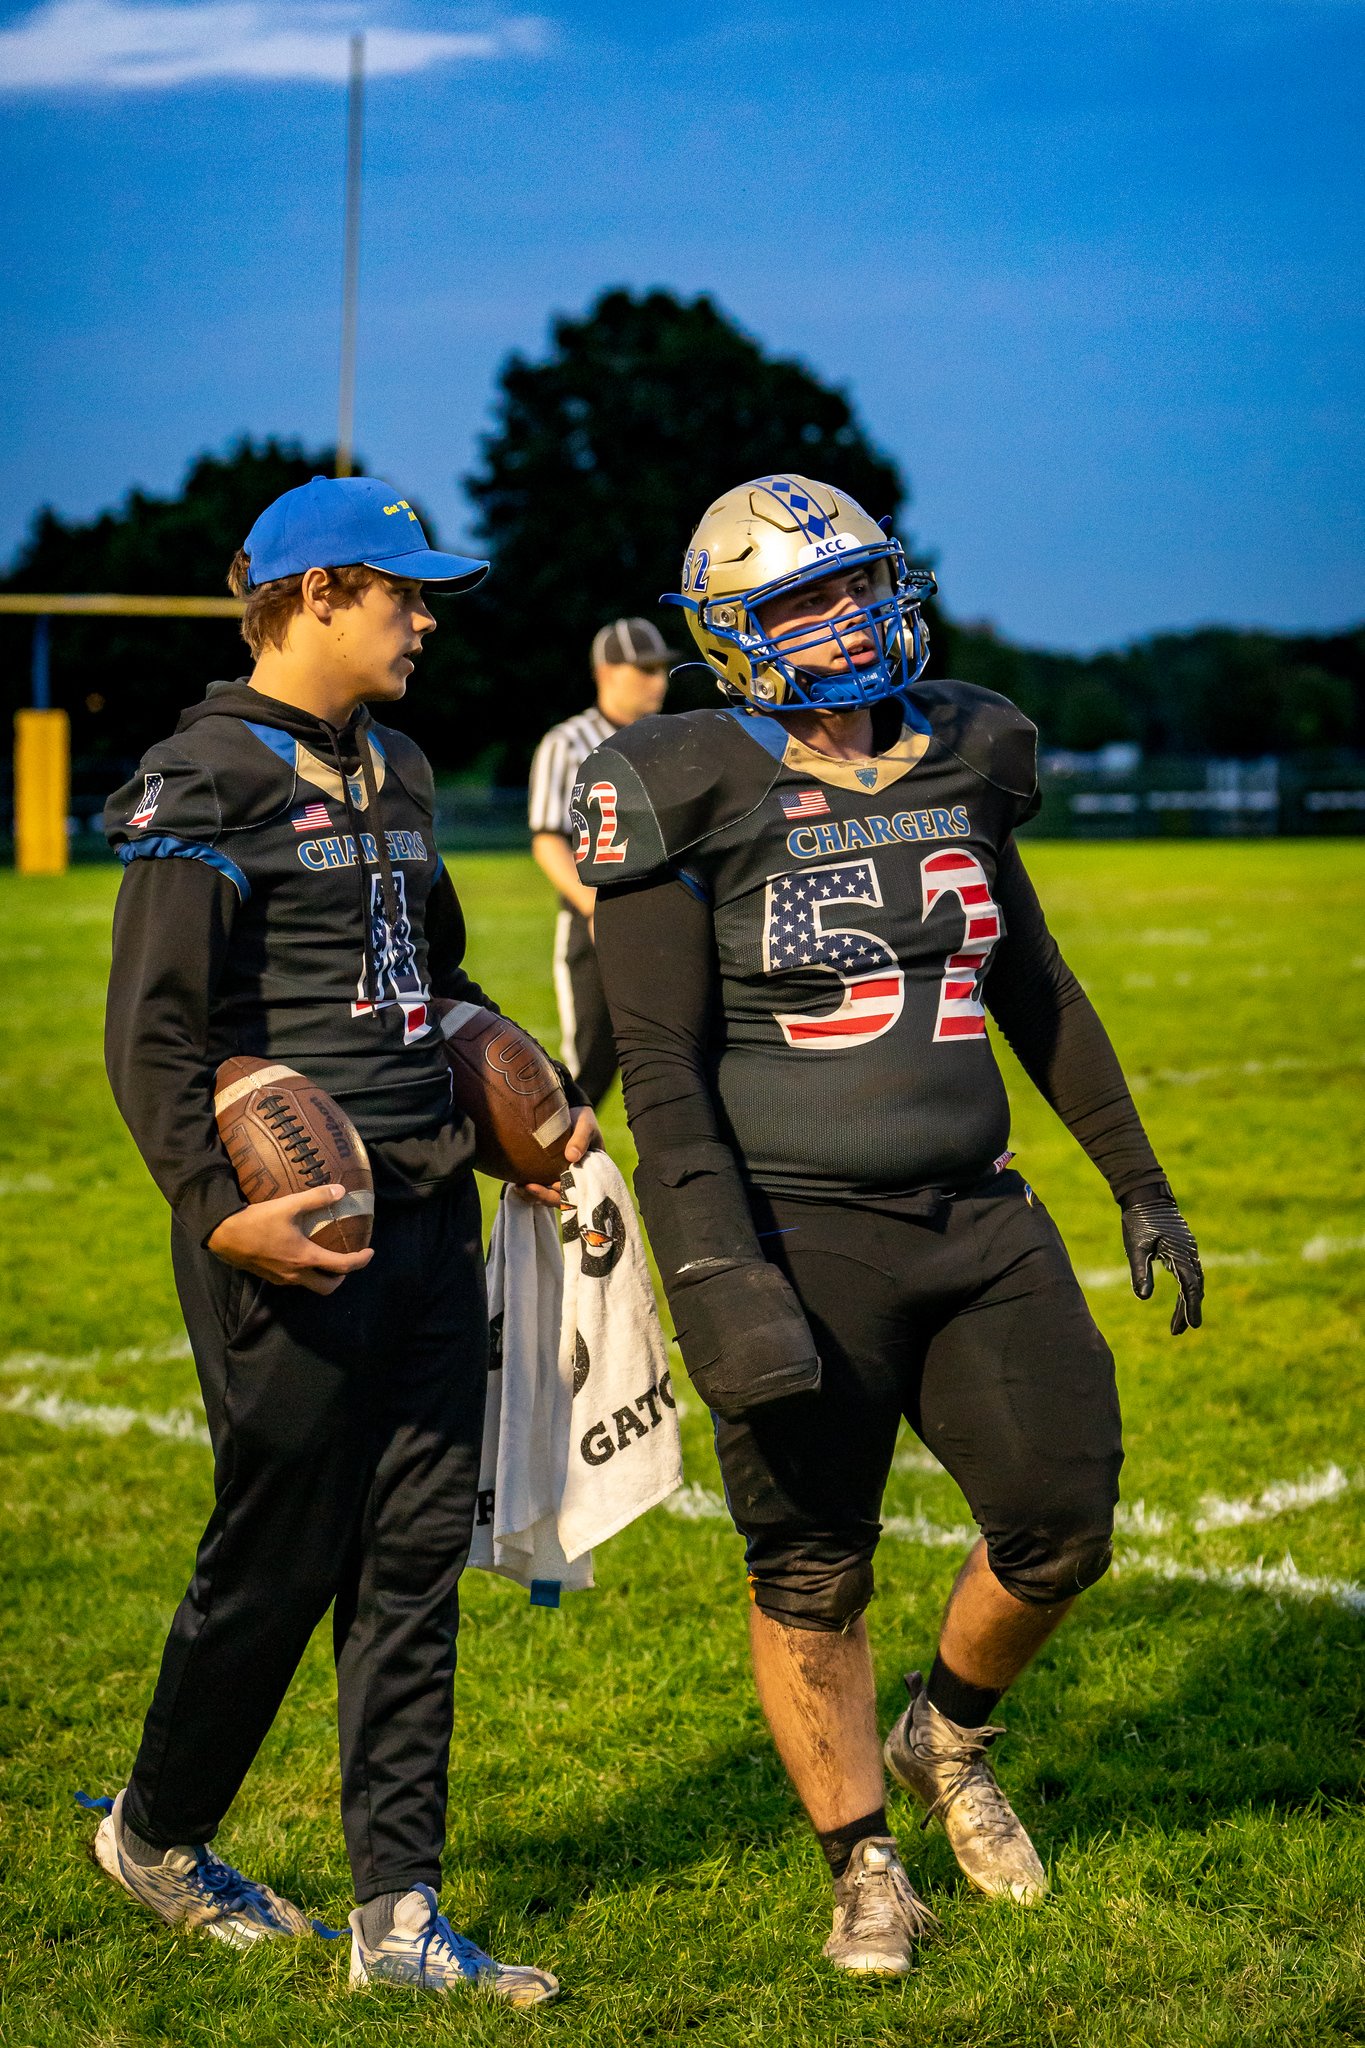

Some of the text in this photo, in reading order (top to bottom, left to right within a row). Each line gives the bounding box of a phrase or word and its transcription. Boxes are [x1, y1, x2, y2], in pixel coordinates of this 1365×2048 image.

[683, 549, 710, 592] 52
[815, 538, 847, 559] ACC
[569, 781, 629, 865] 52
[786, 805, 971, 860] CHARGERS
[298, 830, 428, 872] CHARGERS
[763, 847, 1001, 1051] 52
[309, 1095, 352, 1159] Wilson
